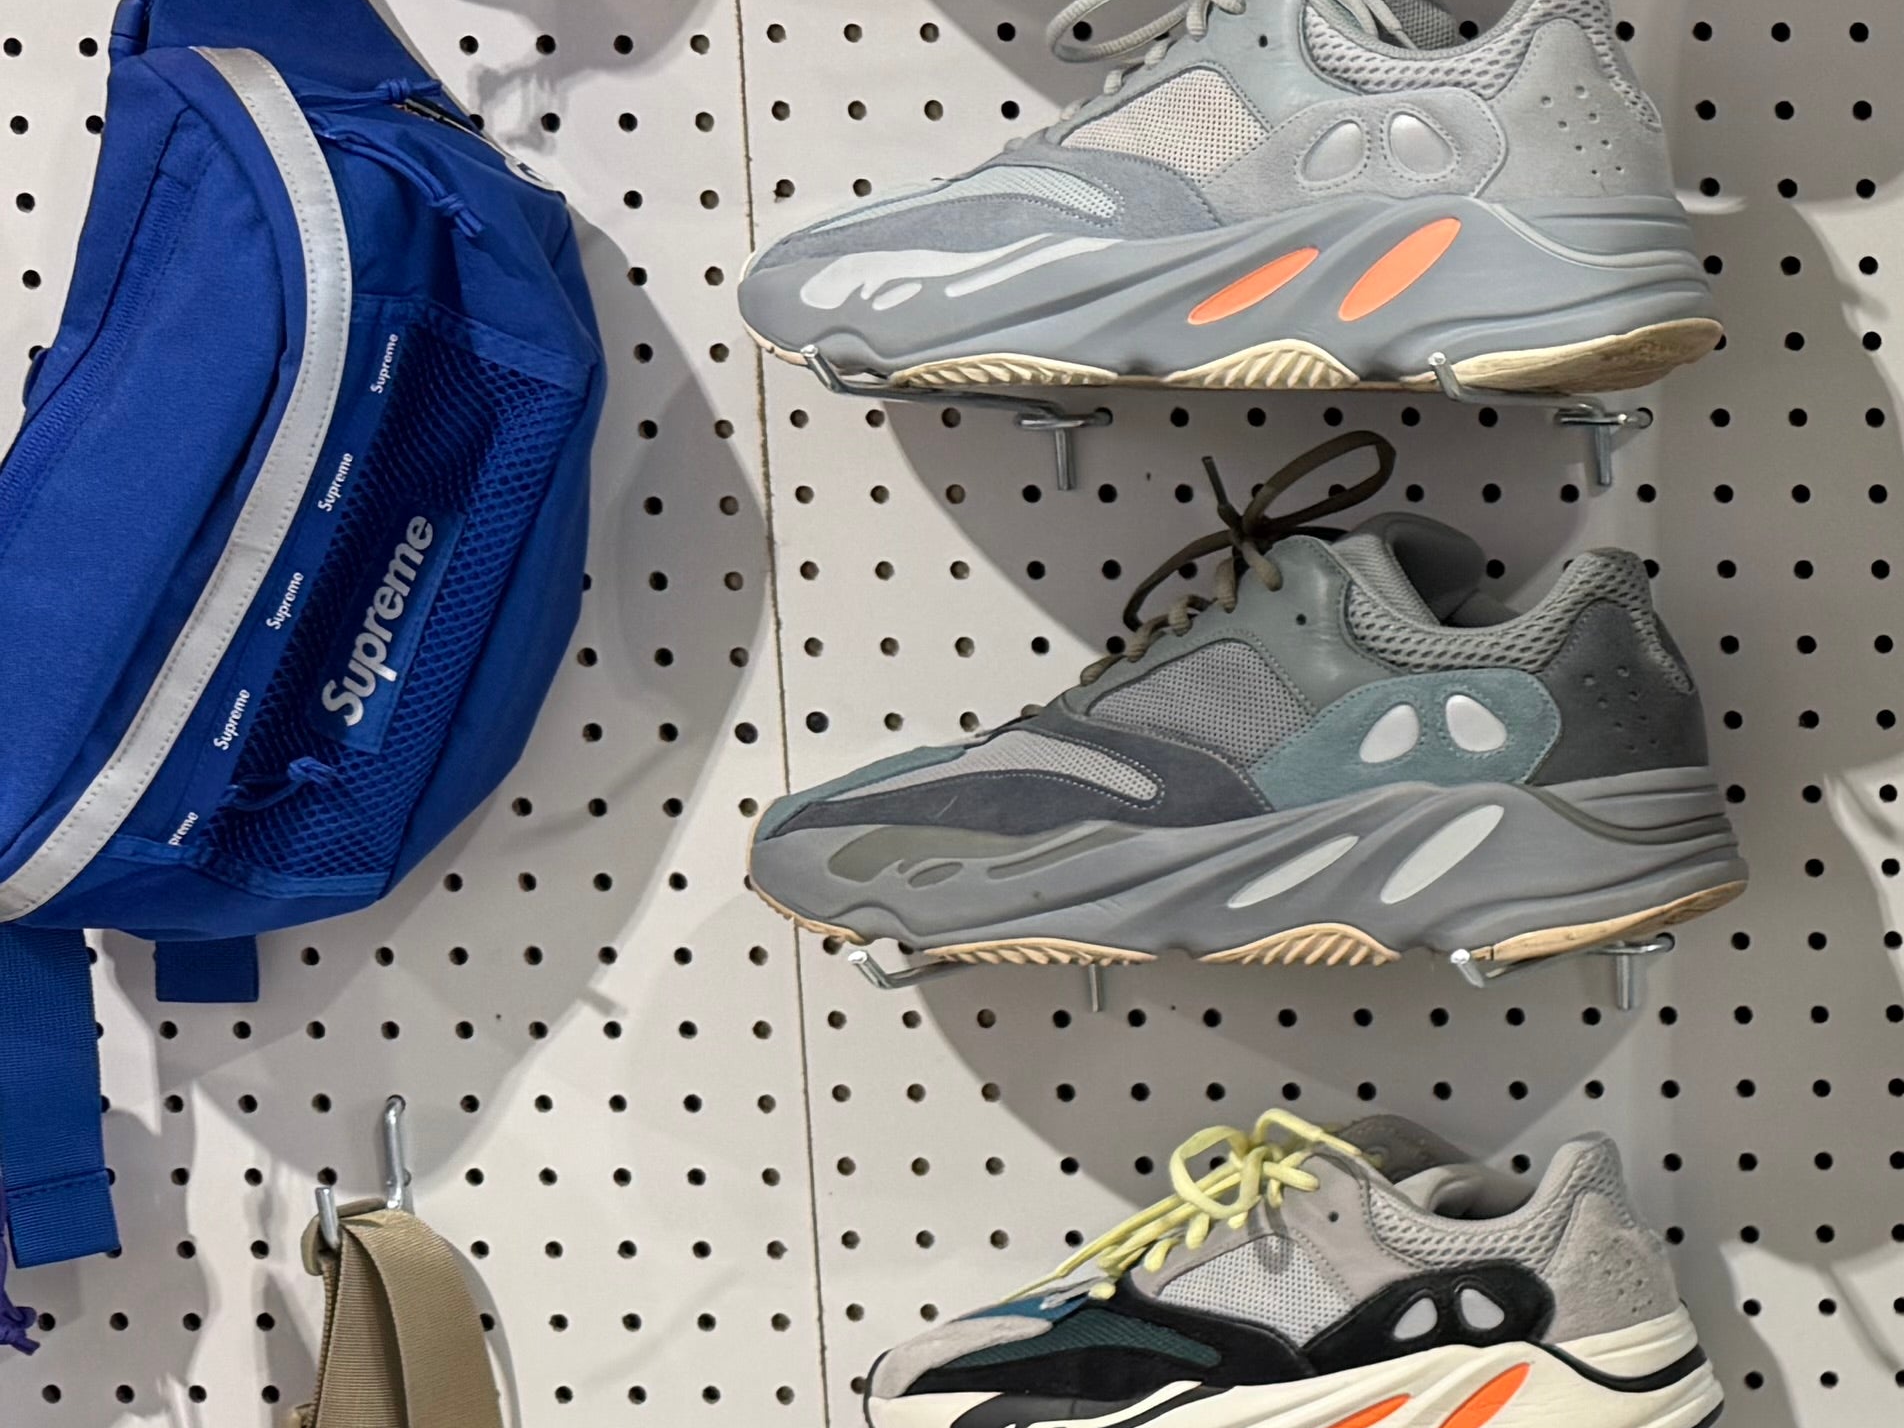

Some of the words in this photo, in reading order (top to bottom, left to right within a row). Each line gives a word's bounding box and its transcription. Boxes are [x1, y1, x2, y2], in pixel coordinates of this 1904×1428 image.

[370, 333, 399, 394] Supreme
[317, 452, 354, 513] Supreme
[266, 570, 304, 631] Supreme
[322, 514, 434, 727] Supreme
[213, 688, 250, 751] Supreme
